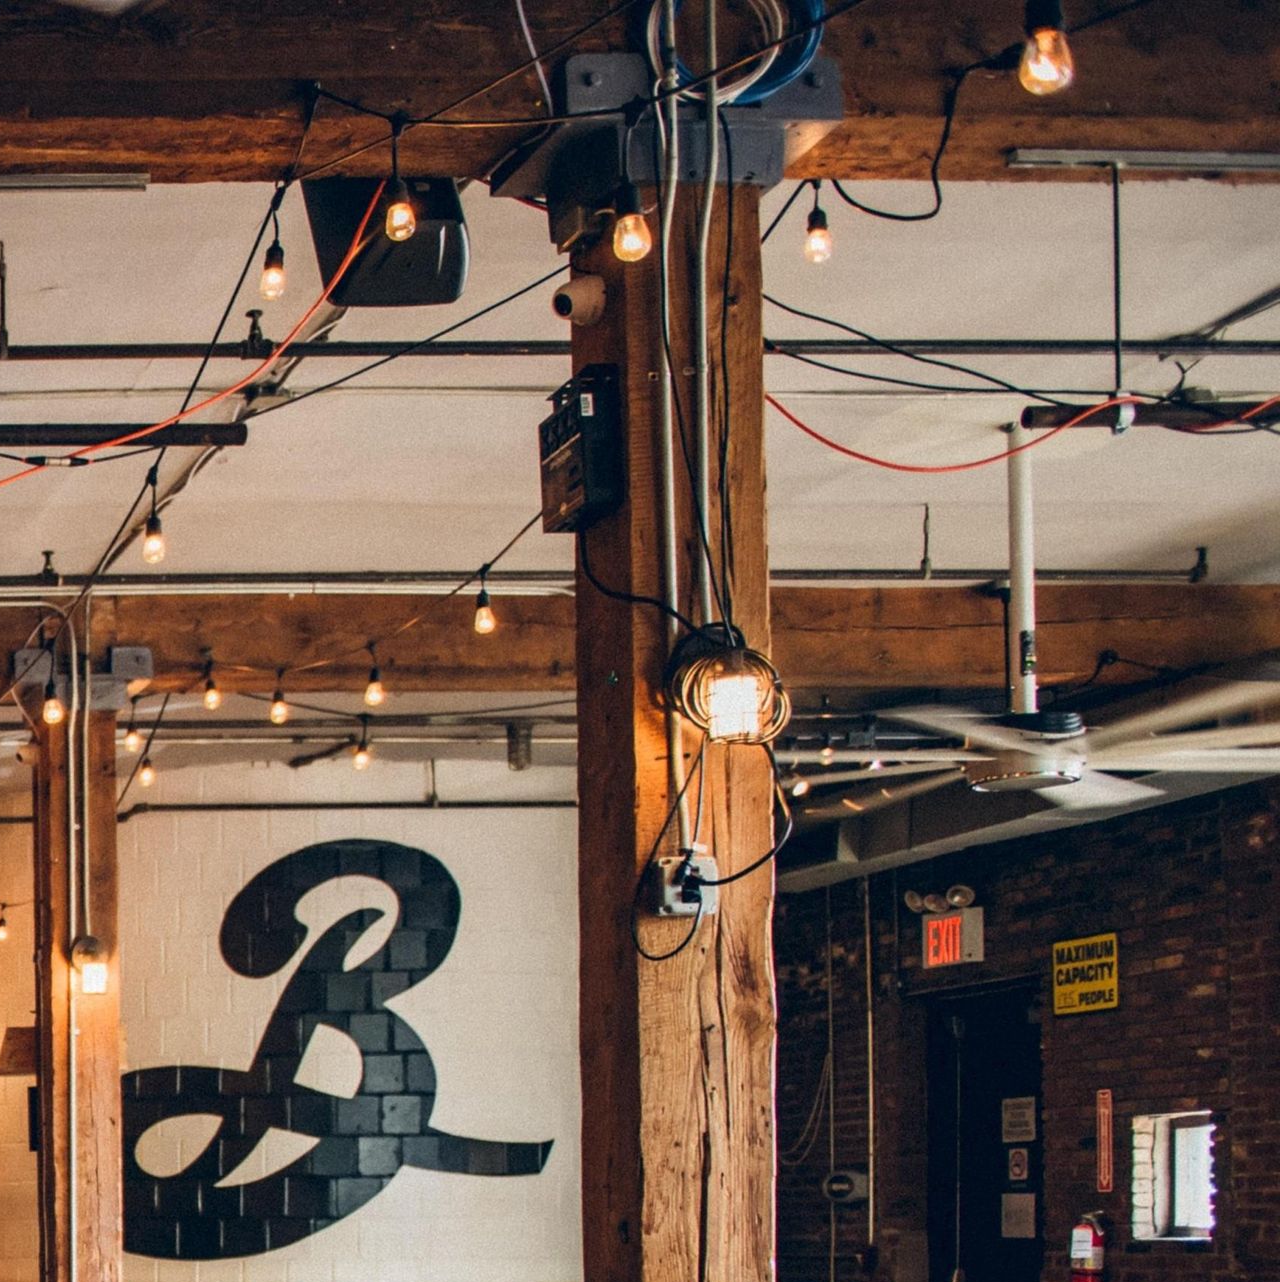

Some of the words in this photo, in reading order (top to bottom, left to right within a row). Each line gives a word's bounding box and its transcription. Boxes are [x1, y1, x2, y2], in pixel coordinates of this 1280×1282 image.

[927, 916, 962, 966] EXIT
[1055, 940, 1114, 963] MAXIMUM
[1056, 962, 1114, 986] CAPACITY
[1078, 988, 1114, 1006] PEOPLE
